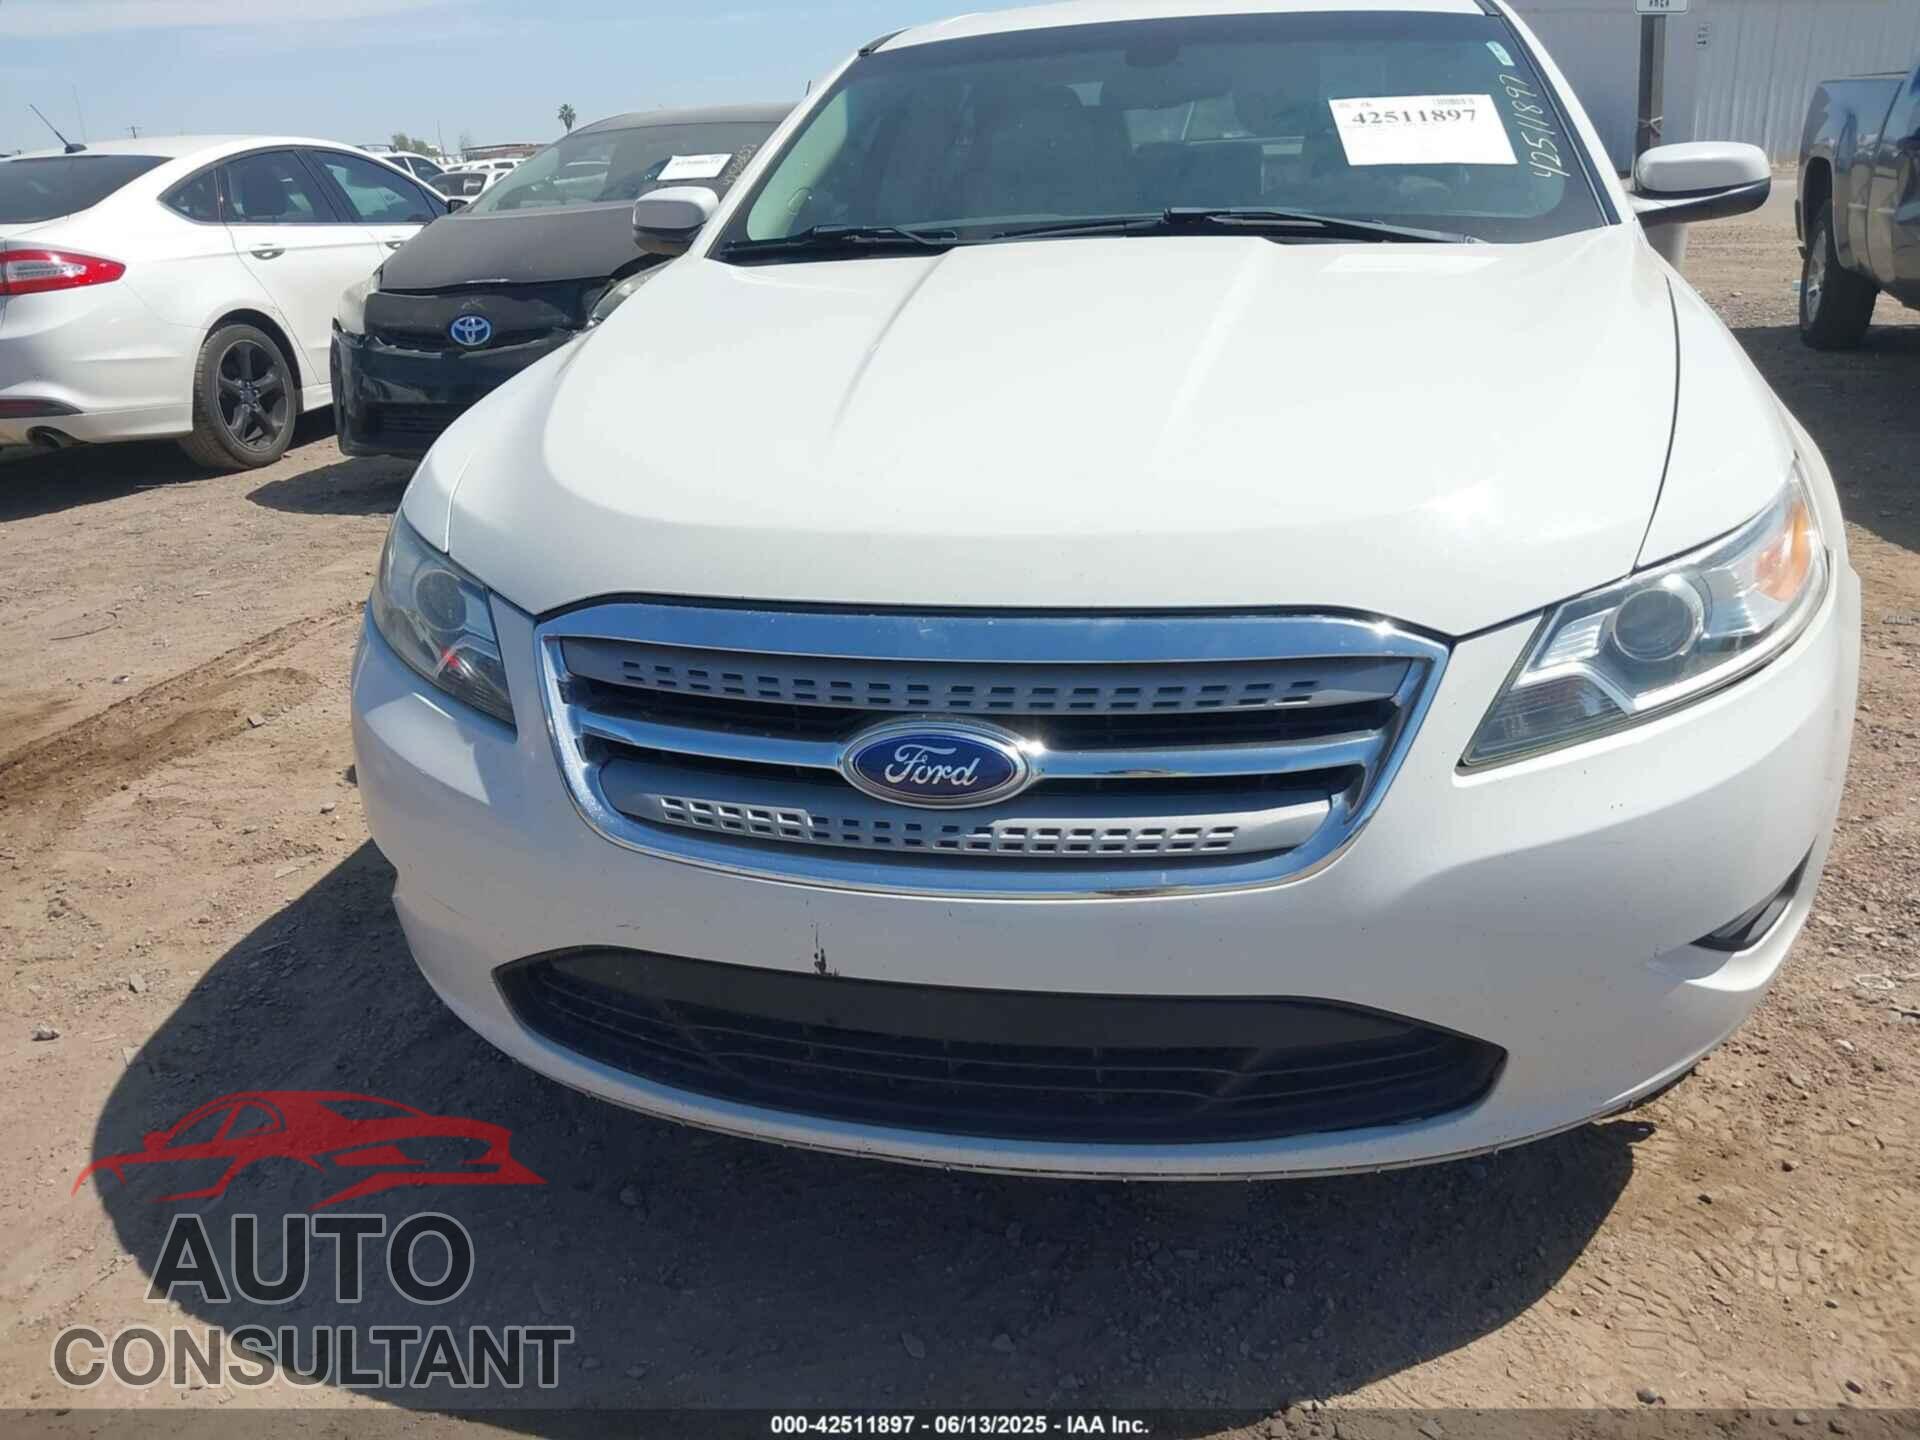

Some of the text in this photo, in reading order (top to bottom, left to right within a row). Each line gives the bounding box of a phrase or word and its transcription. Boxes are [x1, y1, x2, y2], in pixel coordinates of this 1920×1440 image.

[1352, 109, 1477, 124] 42511897
[1499, 73, 1571, 177] 42511897
[884, 744, 981, 786] Ford
